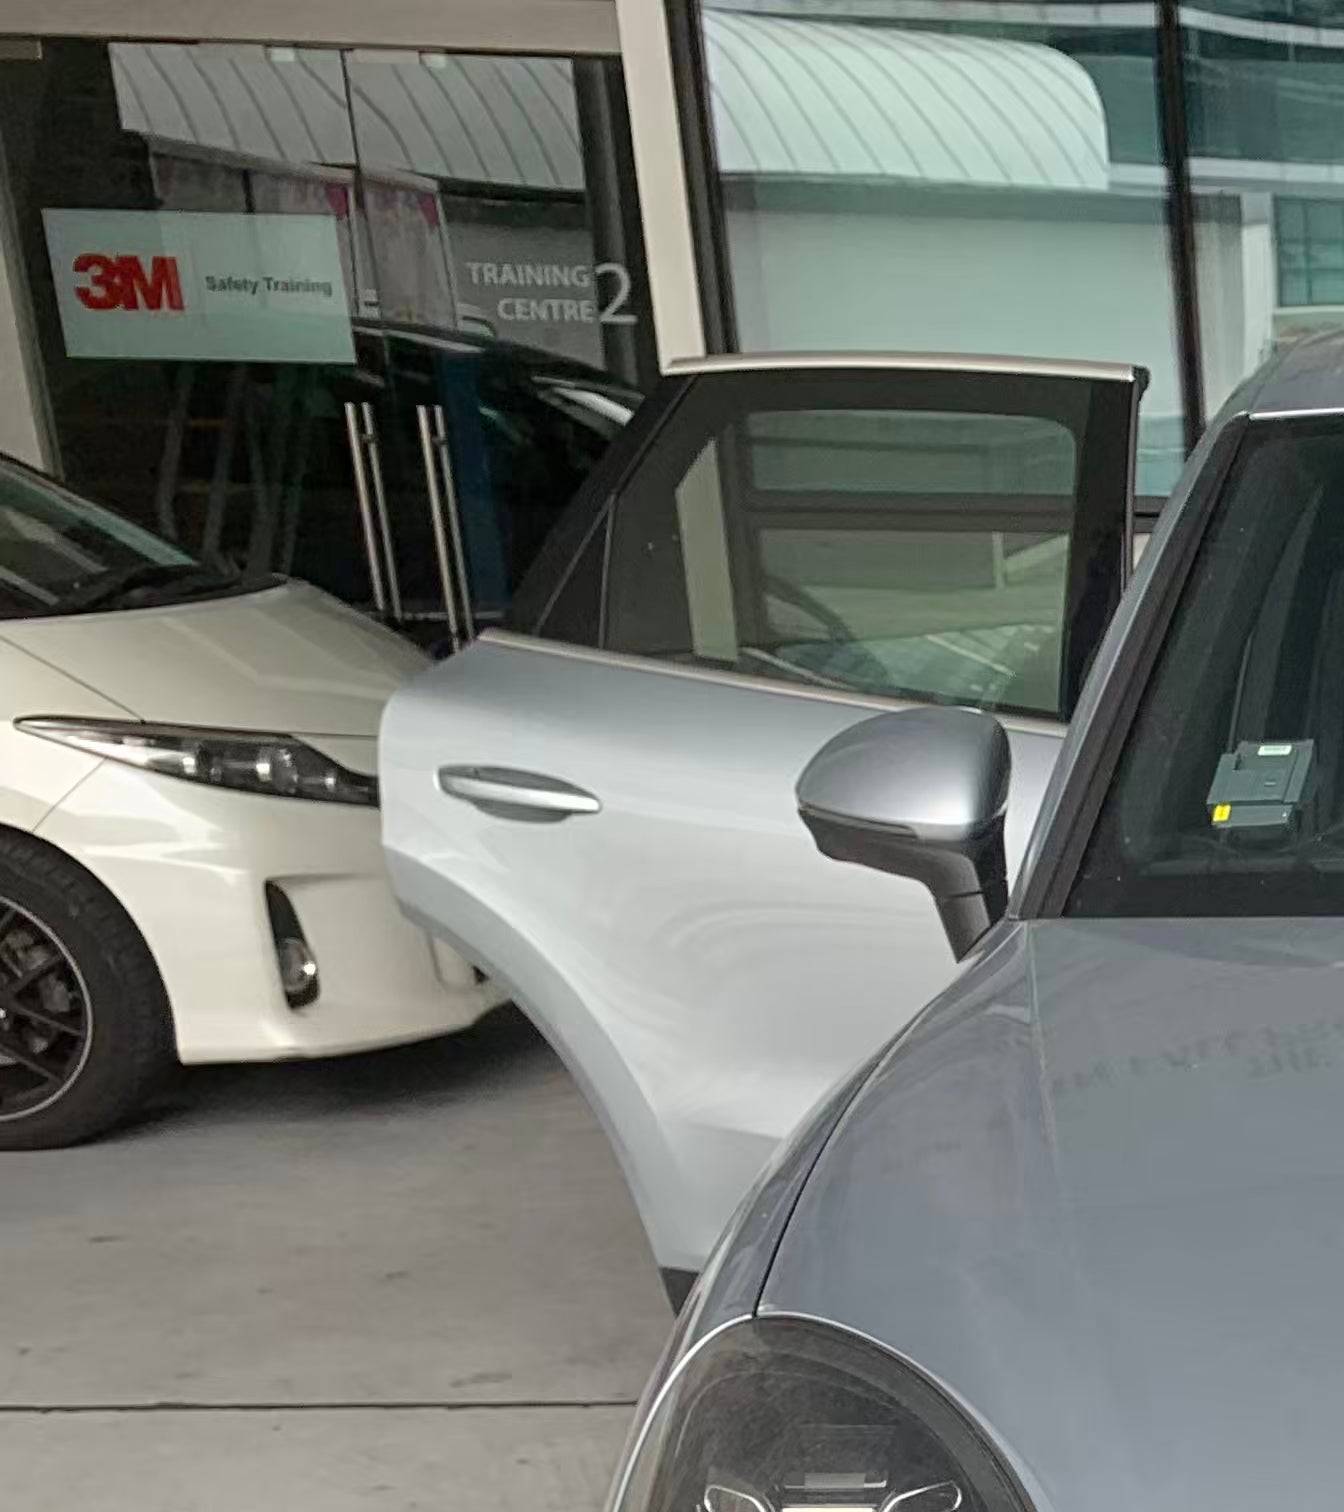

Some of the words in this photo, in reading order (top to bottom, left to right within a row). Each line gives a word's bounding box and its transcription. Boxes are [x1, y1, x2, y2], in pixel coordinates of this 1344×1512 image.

[72, 253, 184, 311] 3M
[204, 275, 258, 295] Safety
[262, 276, 333, 297] Training
[464, 262, 593, 288] TRAINING
[594, 262, 638, 325] 2
[497, 298, 596, 323] CENTRE
